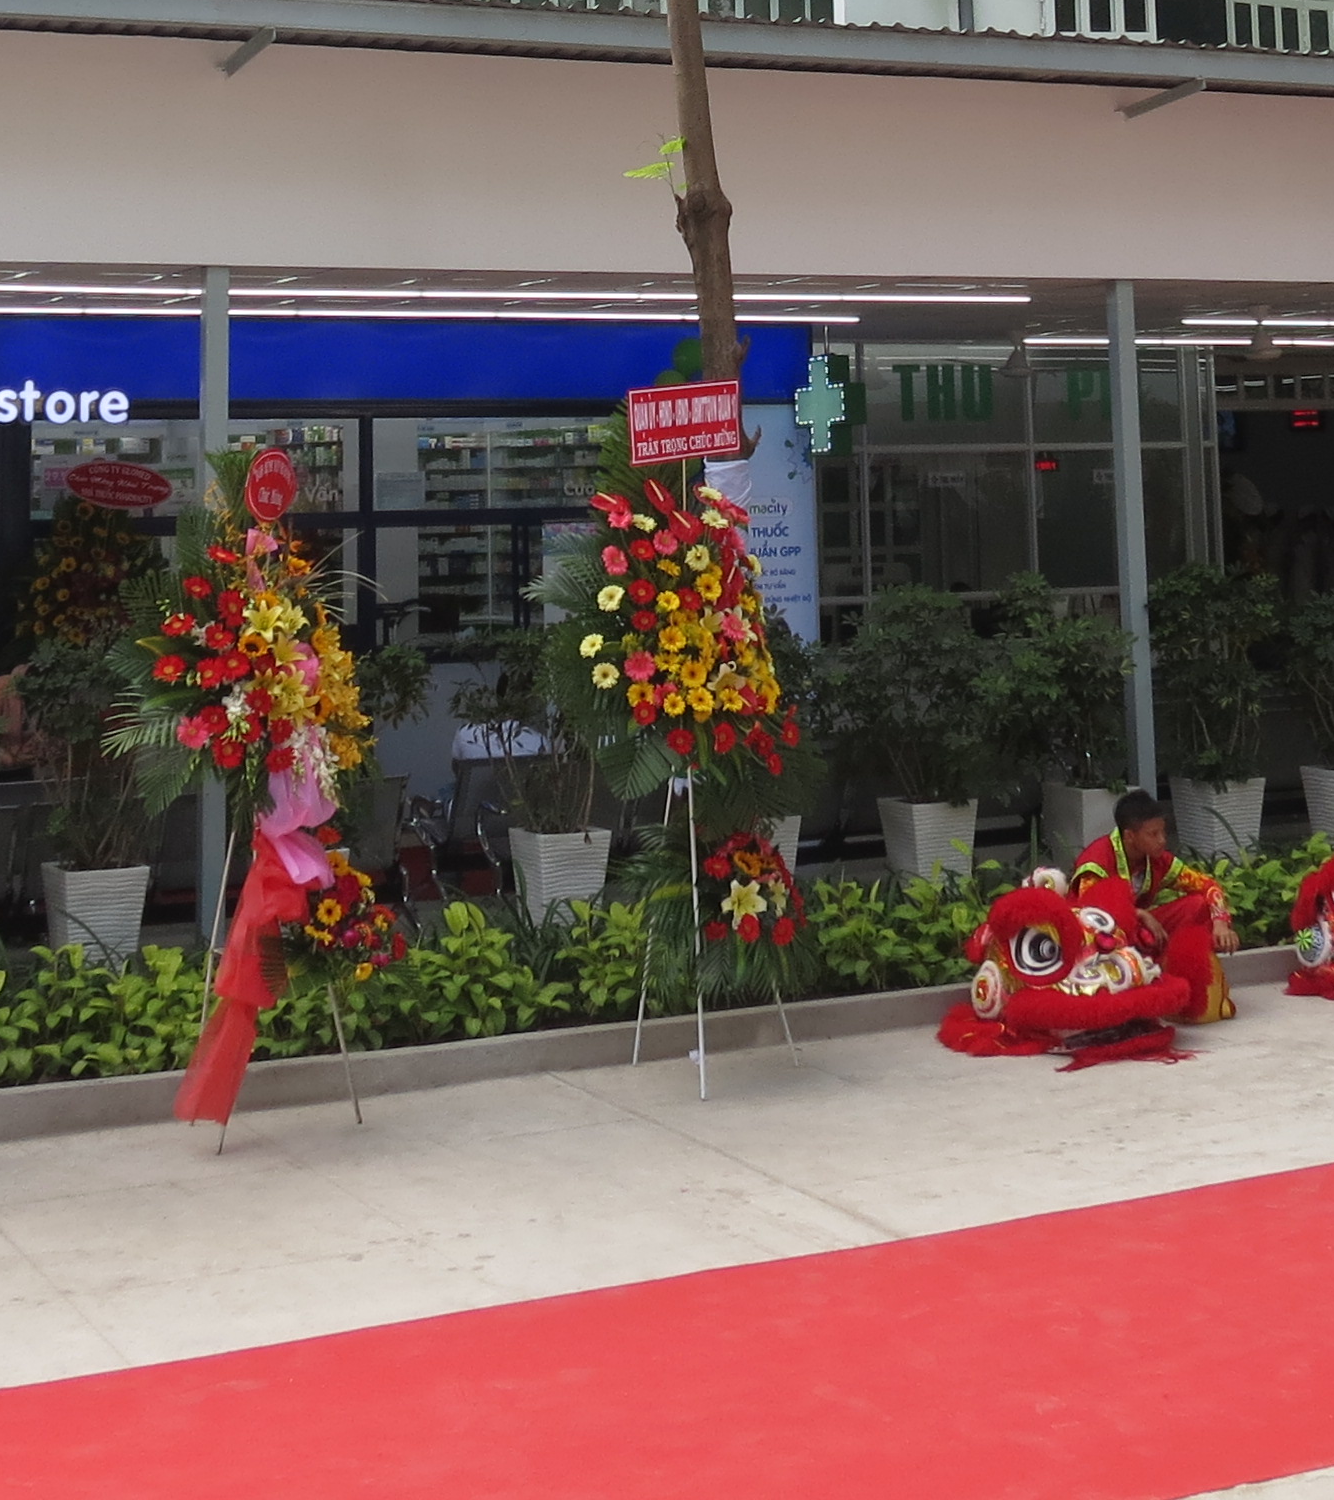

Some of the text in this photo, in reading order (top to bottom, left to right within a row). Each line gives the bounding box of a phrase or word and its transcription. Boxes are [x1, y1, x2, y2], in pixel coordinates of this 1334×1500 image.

[892, 364, 993, 421] THU
[689, 431, 712, 450] CHÚC
[110, 465, 121, 475] TY
[749, 498, 788, 516] macity
[751, 520, 789, 538] THUỐC
[780, 546, 801, 557] GPP
